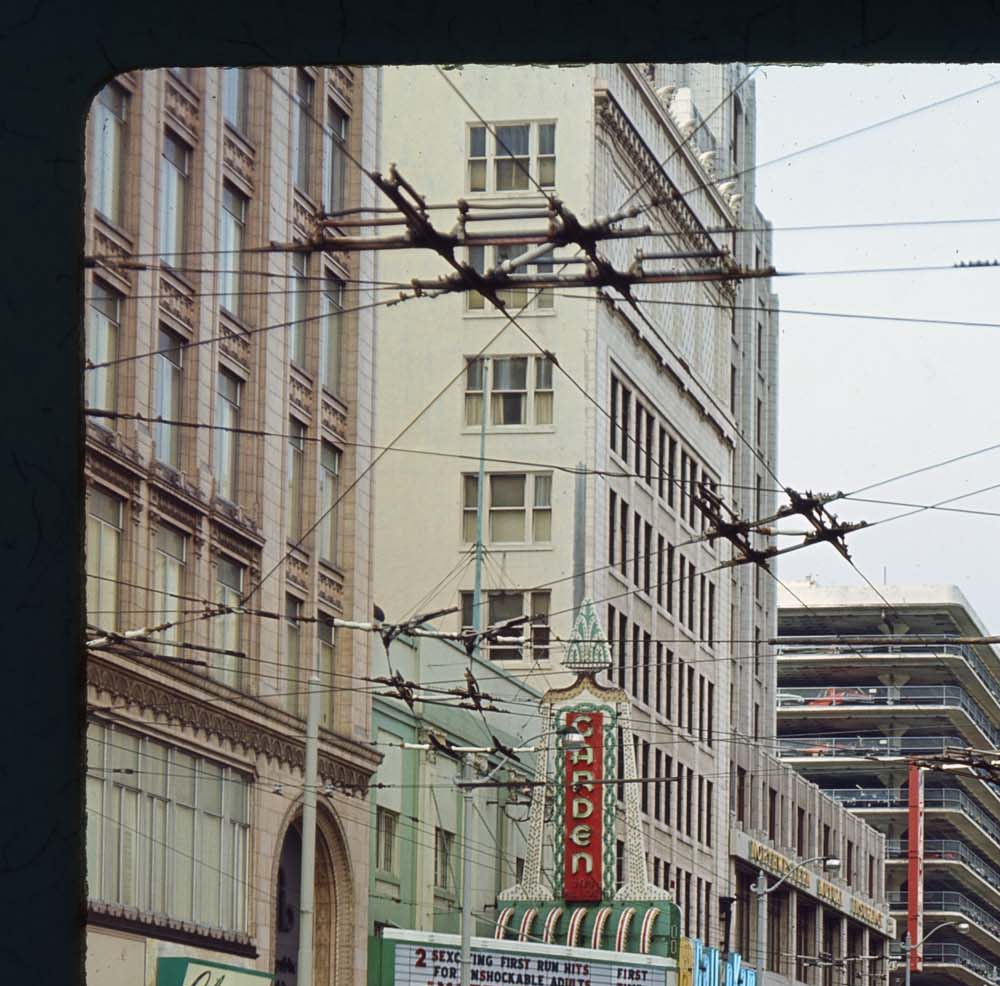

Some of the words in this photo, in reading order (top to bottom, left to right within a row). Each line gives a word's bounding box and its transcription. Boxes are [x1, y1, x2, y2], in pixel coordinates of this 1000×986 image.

[415, 948, 427, 968] 2
[431, 950, 493, 966] SEXCING
[500, 956, 532, 970] FIRST
[537, 959, 559, 972] RUN
[564, 962, 589, 975] HITS
[433, 966, 457, 979] FOR
[470, 969, 545, 986] NSHOCKABLE
[616, 968, 648, 981] FIRST
